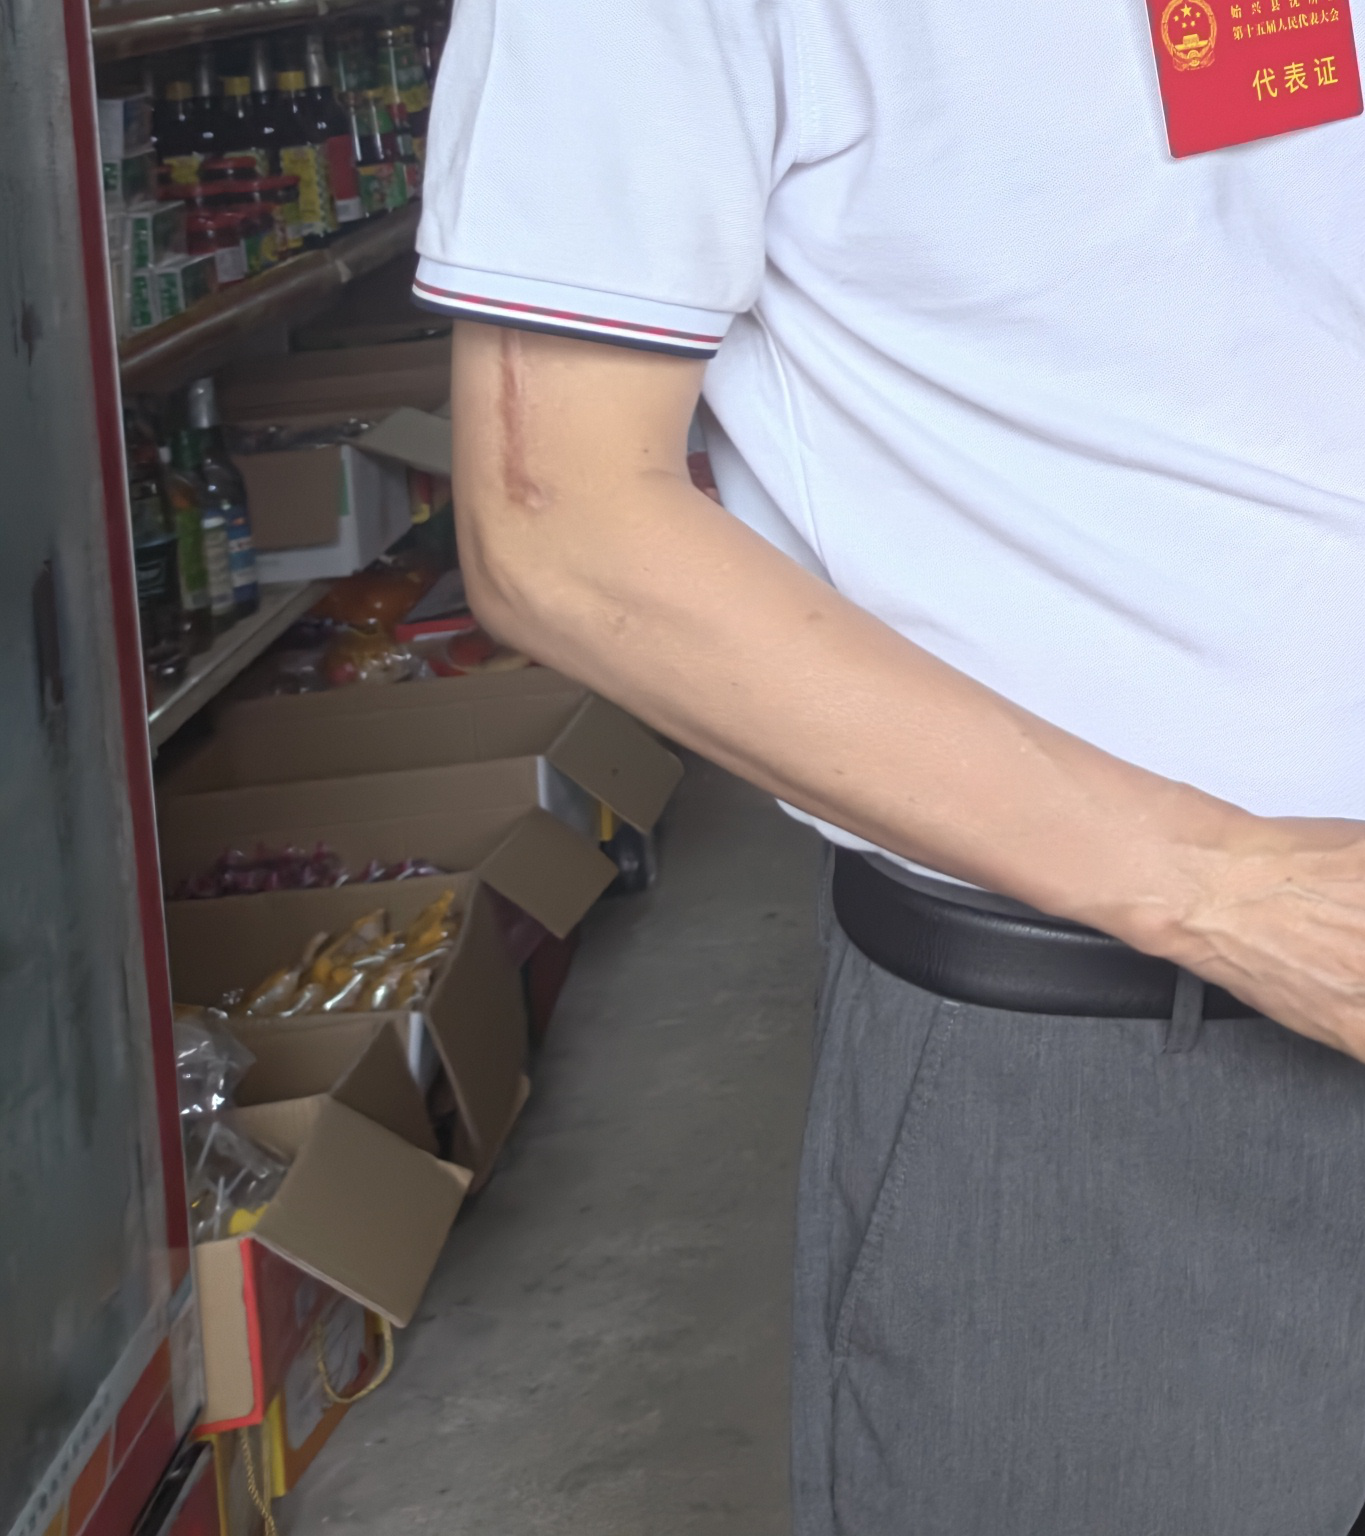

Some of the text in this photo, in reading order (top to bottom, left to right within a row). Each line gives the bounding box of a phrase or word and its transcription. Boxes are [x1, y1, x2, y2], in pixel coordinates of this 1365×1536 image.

[1232, 7, 1340, 41] 第十五届人民代表大会
[1252, 55, 1339, 101] 代表证
